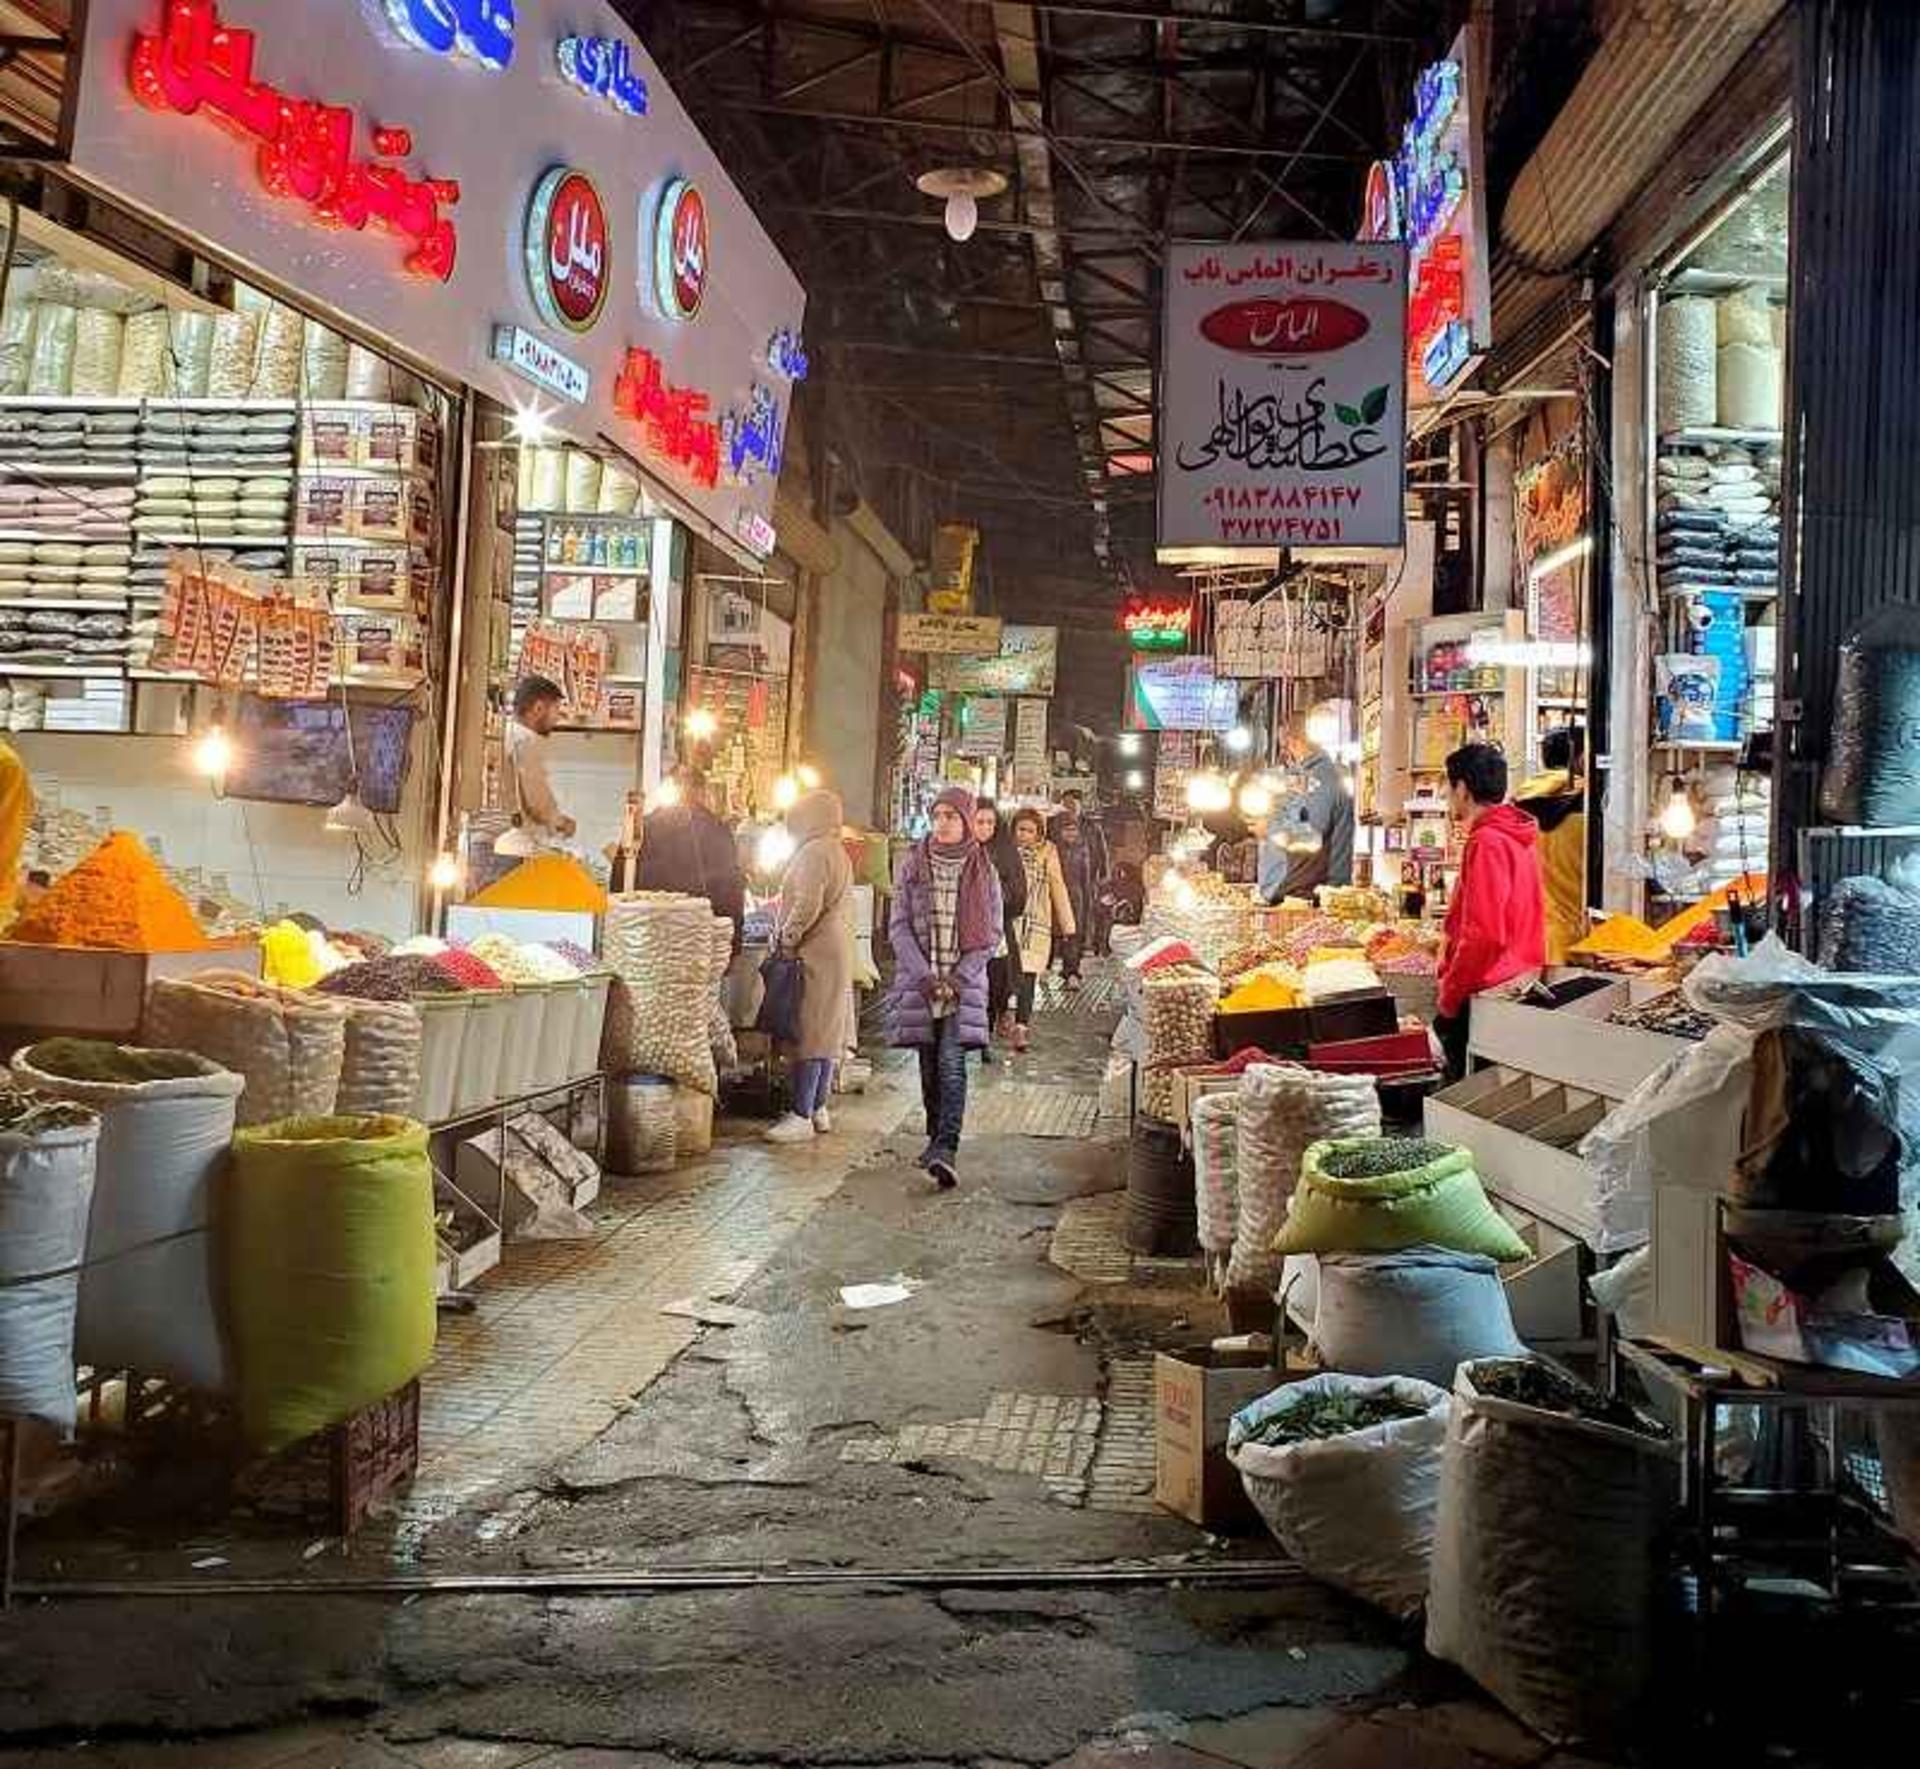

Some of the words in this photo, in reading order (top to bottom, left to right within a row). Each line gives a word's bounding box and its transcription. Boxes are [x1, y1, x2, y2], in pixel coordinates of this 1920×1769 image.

[1183, 255, 1220, 287] ناب
[1226, 256, 1293, 285] الماس
[1297, 254, 1393, 285] زعفران
[1247, 305, 1320, 347] الماس
[1204, 485, 1362, 510] ۰۹۱۸۳۸۸۴۱۴۷
[1221, 518, 1341, 540] ۳۷۲۷۴۷۵۱
